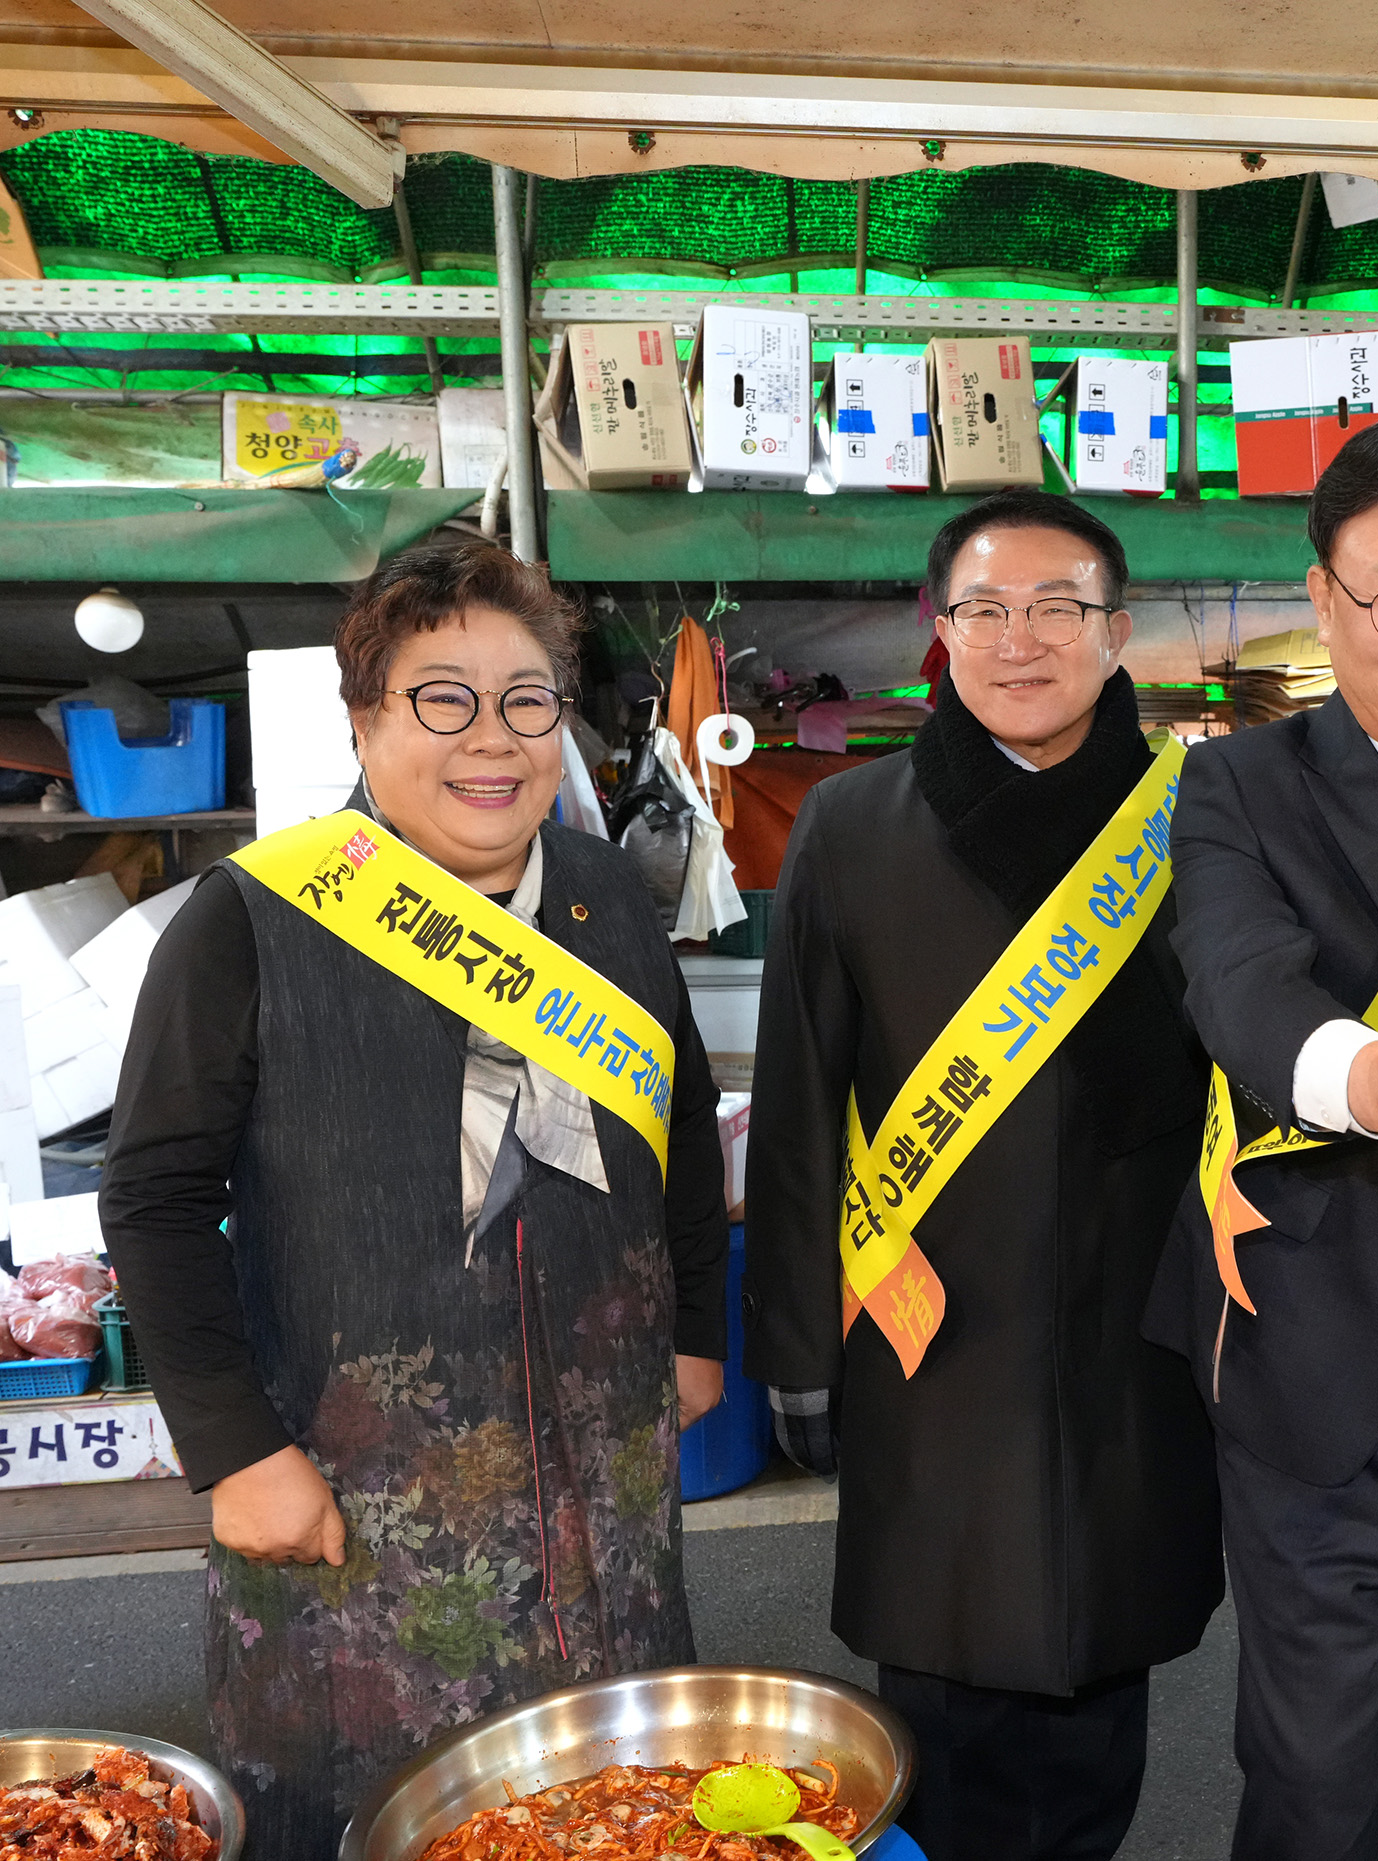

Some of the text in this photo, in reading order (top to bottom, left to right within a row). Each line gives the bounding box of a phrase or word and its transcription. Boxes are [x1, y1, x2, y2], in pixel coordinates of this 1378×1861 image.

[598, 358, 619, 414] 메추리알
[961, 372, 980, 427] 메추리알
[1350, 347, 1371, 399] 장수사과
[298, 414, 339, 435] 속사
[745, 387, 758, 436] 장수사과
[375, 882, 536, 1004] 전통시장
[981, 921, 1100, 1063] 장보기
